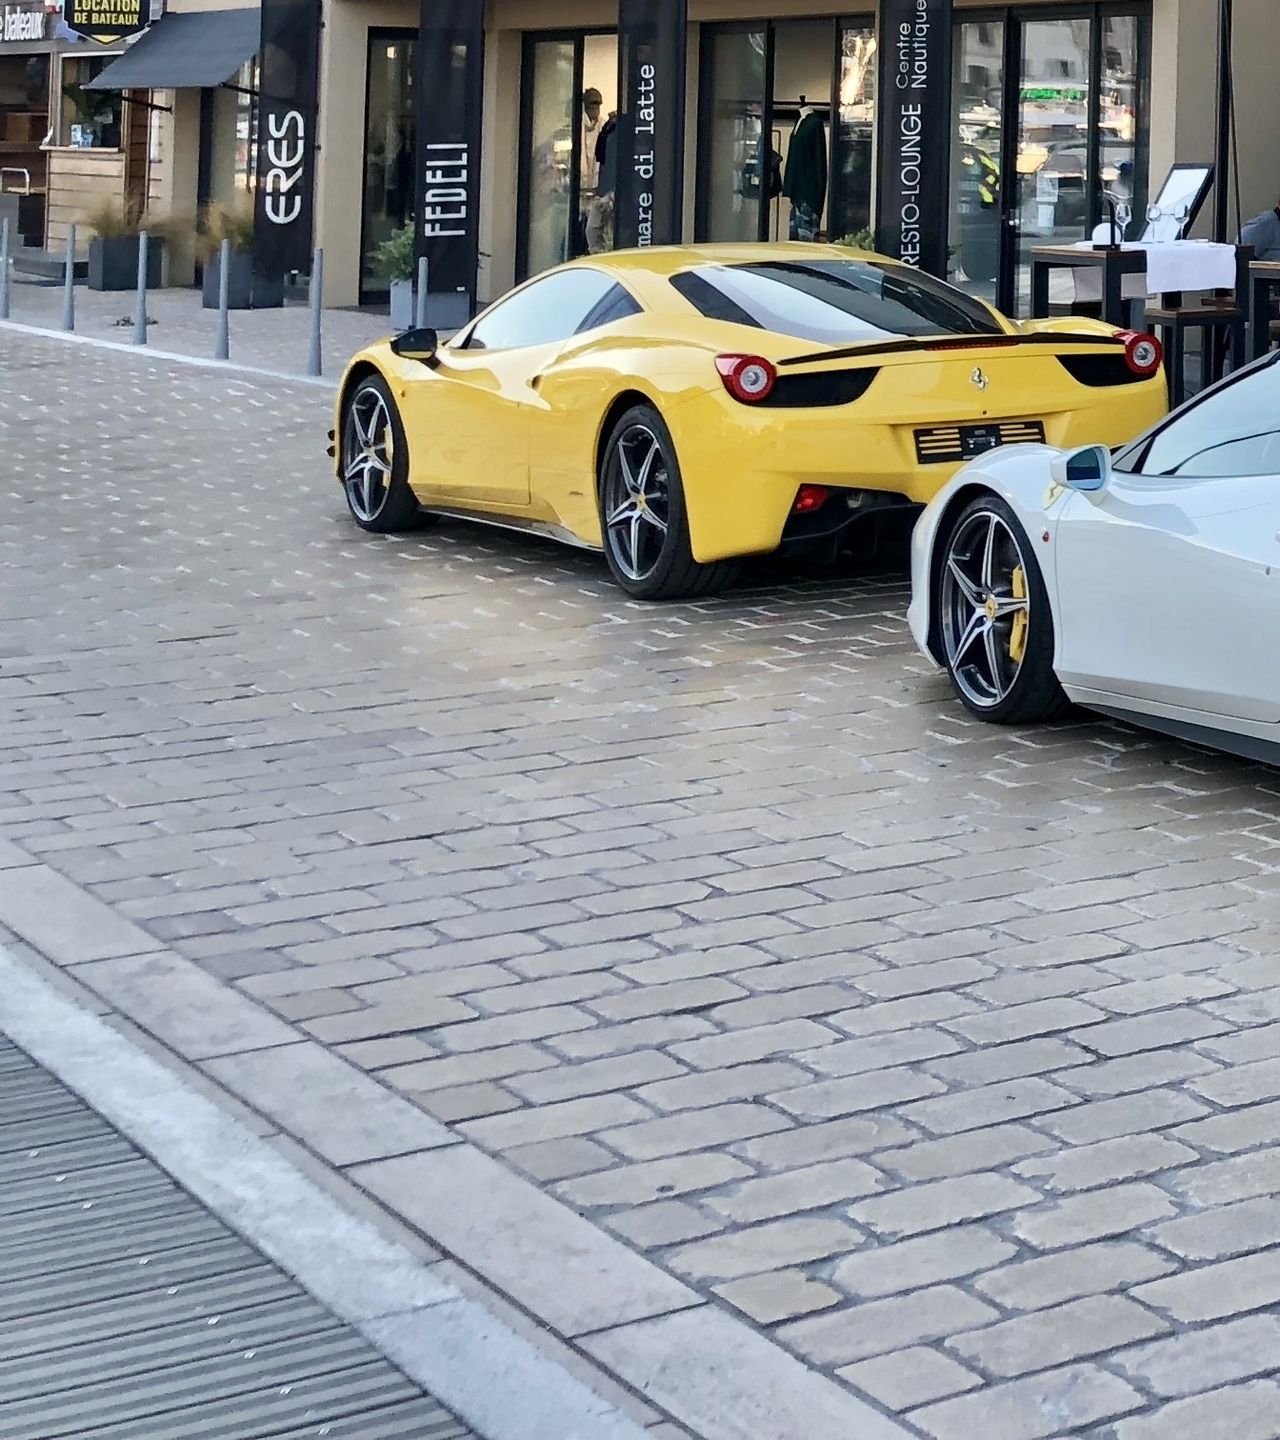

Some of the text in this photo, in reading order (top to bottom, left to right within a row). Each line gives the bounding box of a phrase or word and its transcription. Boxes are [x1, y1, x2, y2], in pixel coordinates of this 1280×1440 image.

[73, 12, 139, 26] DE BATEAUX
[911, 0, 930, 88] Nautique
[895, 22, 911, 89] Centre
[635, 64, 655, 135] latte
[265, 110, 305, 224] ERES
[425, 143, 468, 237] FEDELI
[634, 151, 654, 179] di
